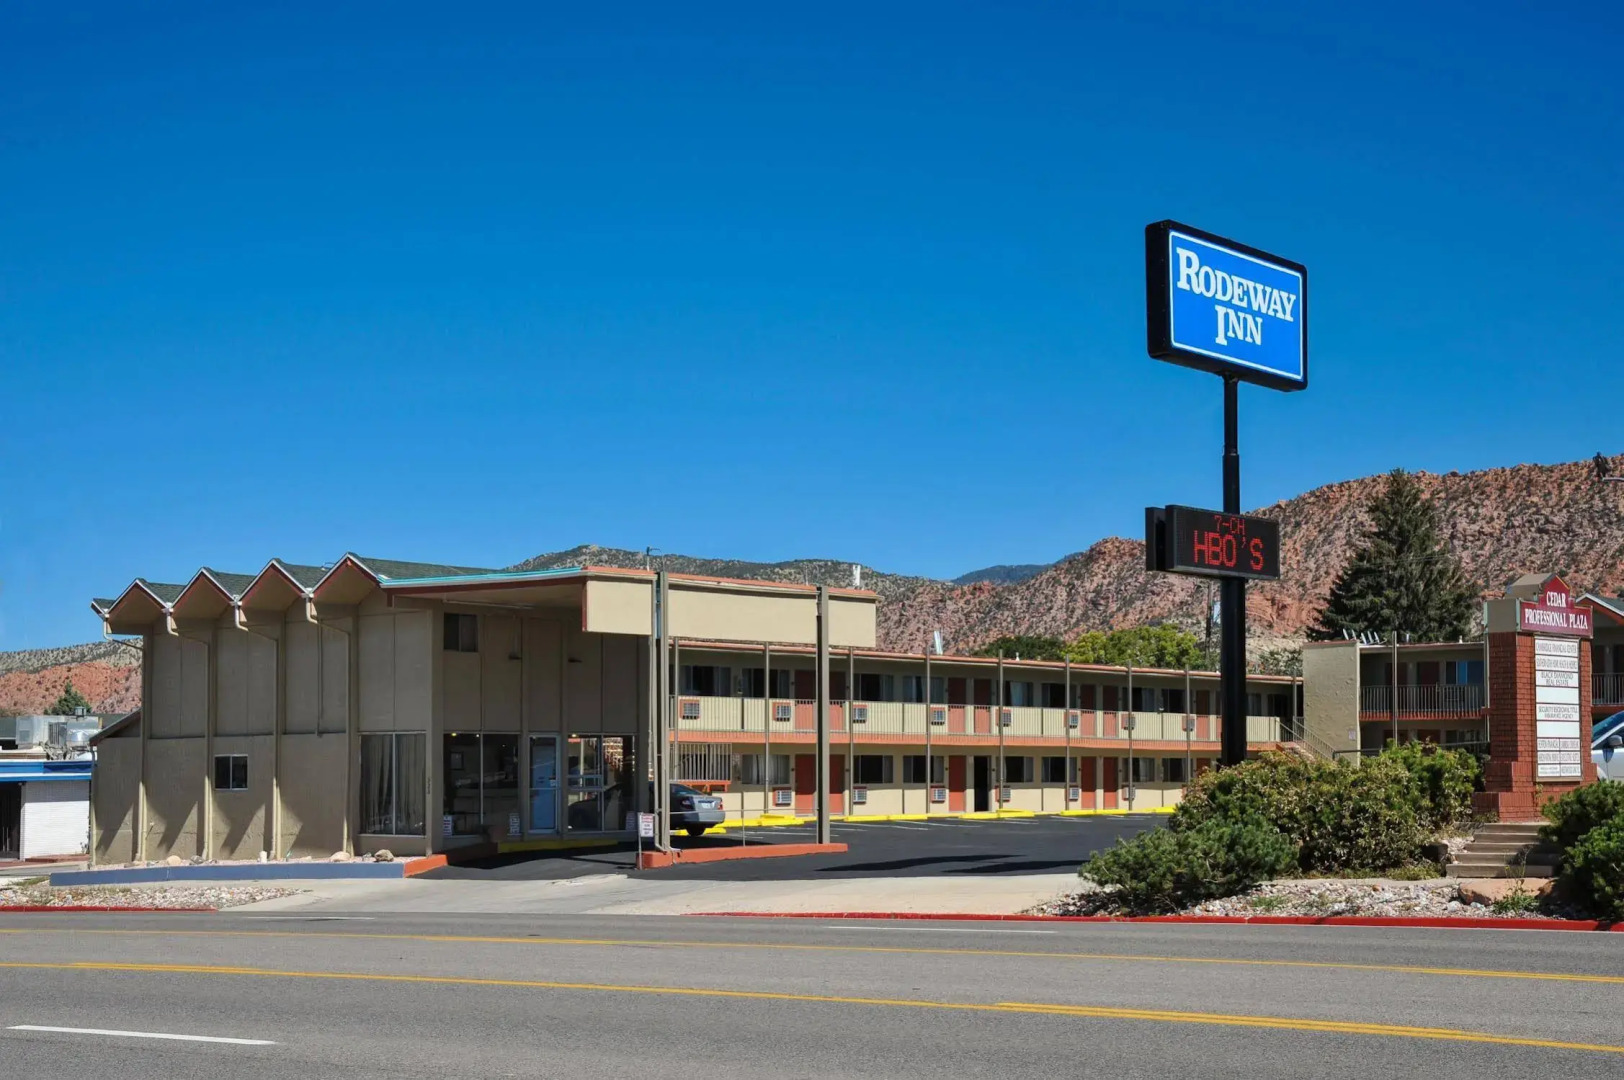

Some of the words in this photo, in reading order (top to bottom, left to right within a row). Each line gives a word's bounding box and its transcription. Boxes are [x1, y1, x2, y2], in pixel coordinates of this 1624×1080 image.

[1176, 246, 1296, 322] RODEWAY
[1215, 304, 1263, 346] INN
[1546, 591, 1566, 608] CEDAR
[1524, 608, 1567, 628] PROFESSIONAL
[1569, 613, 1588, 629] PLAZA
